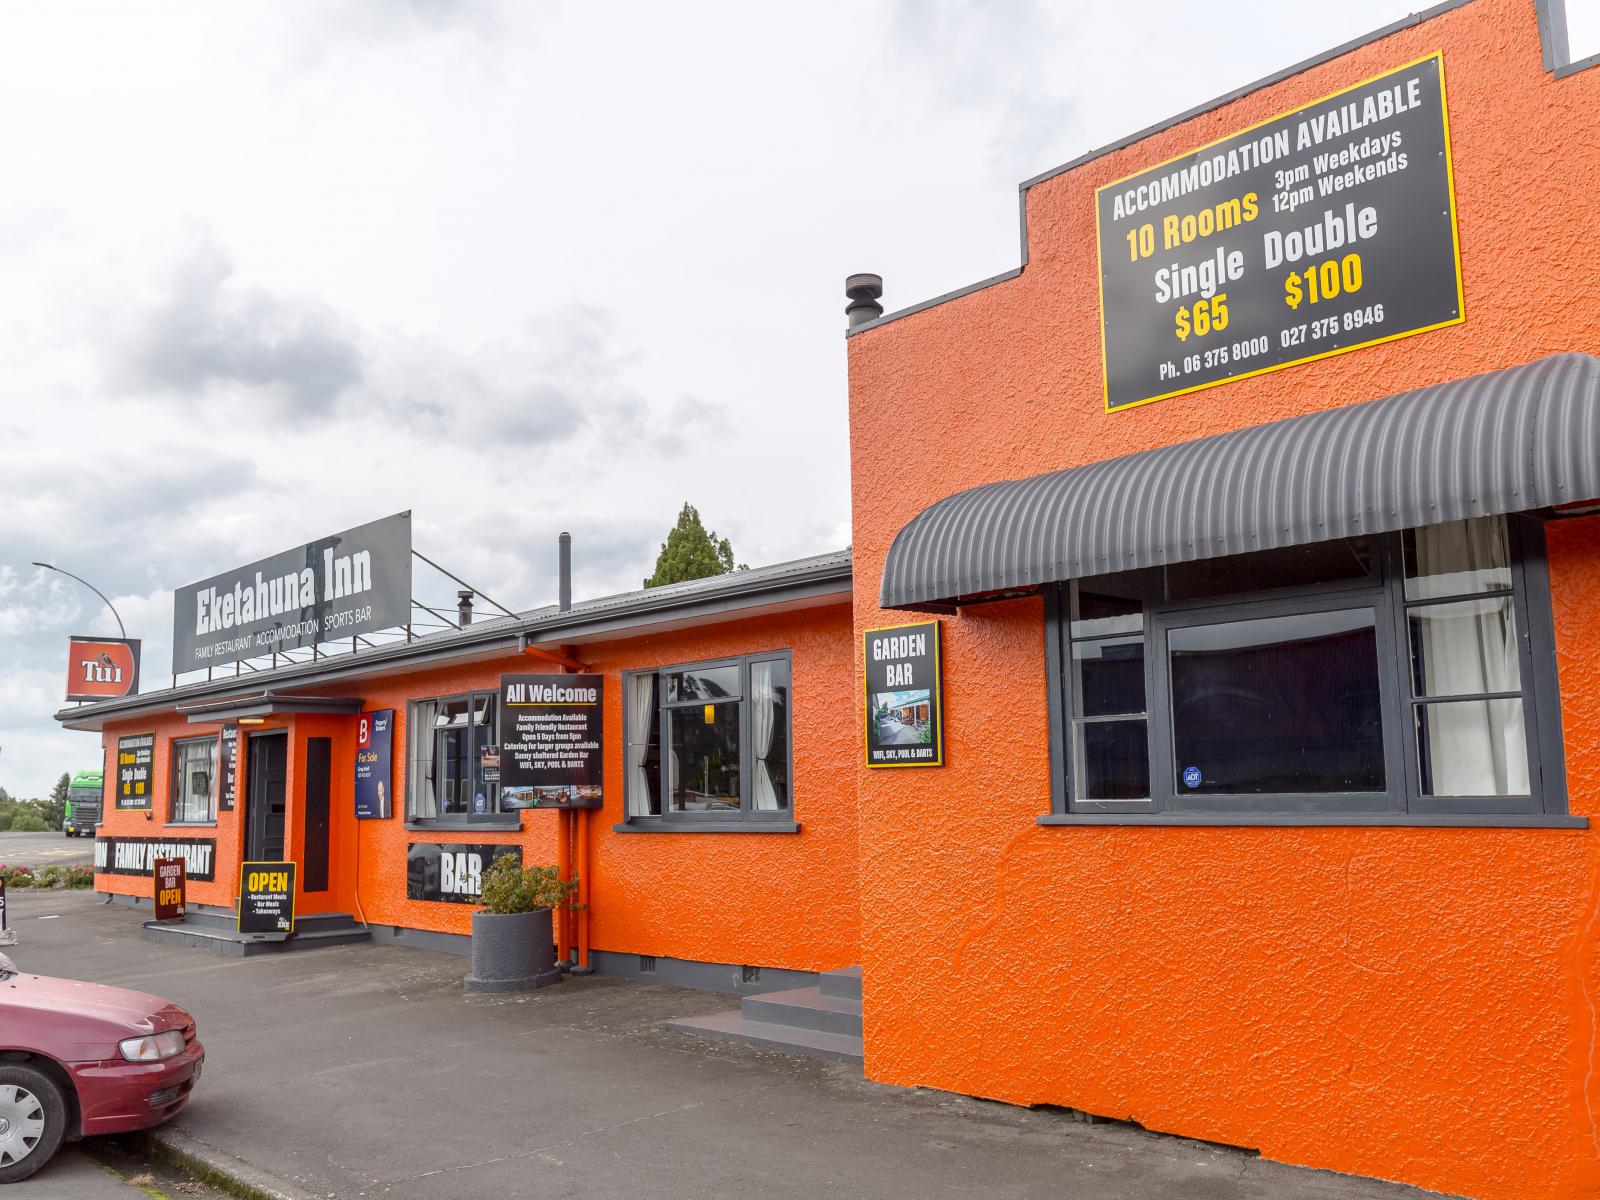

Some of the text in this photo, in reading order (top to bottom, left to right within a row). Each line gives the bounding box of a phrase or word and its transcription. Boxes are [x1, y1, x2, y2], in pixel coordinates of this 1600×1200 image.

[1113, 78, 1421, 221] ACCOMMODATION AVAILABLE
[1274, 130, 1402, 190] 3pm Weekdays
[1272, 151, 1408, 213] 12pm Weekends
[1126, 192, 1259, 262] 10 Rooms
[1154, 202, 1378, 304] Single Double
[1175, 253, 1363, 342] $65 $100
[1160, 303, 1384, 380] Ph. 06 375 8000 027 375 8946
[195, 547, 372, 635] Eketahuna Inn
[195, 605, 372, 659] FAMILY RESTAURANT ACCOMMODATION SPORTS BAR
[873, 634, 926, 661] GARDEN
[81, 661, 122, 683] Tui
[886, 663, 913, 687] BAR
[506, 683, 597, 702] All Welcome
[516, 723, 534, 732] Family
[535, 723, 557, 732] Friendly
[522, 733, 536, 742] Open
[541, 733, 555, 741] Days
[358, 752, 378, 763] For Sale
[504, 743, 528, 751] Catering
[537, 743, 554, 751] larger
[555, 743, 573, 751] groups
[514, 752, 532, 760] Sunny
[886, 750, 897, 760] SKY,
[898, 749, 910, 758] POOL
[911, 748, 916, 758] &
[916, 748, 932, 758] DARTS
[114, 843, 147, 869] FAMILY
[160, 865, 180, 878] GARDEN
[165, 877, 176, 889] BAR
[248, 872, 288, 892] OPEN
[441, 852, 482, 895] BAR
[160, 888, 181, 906] OPEN
[255, 908, 281, 916] Takeaways
